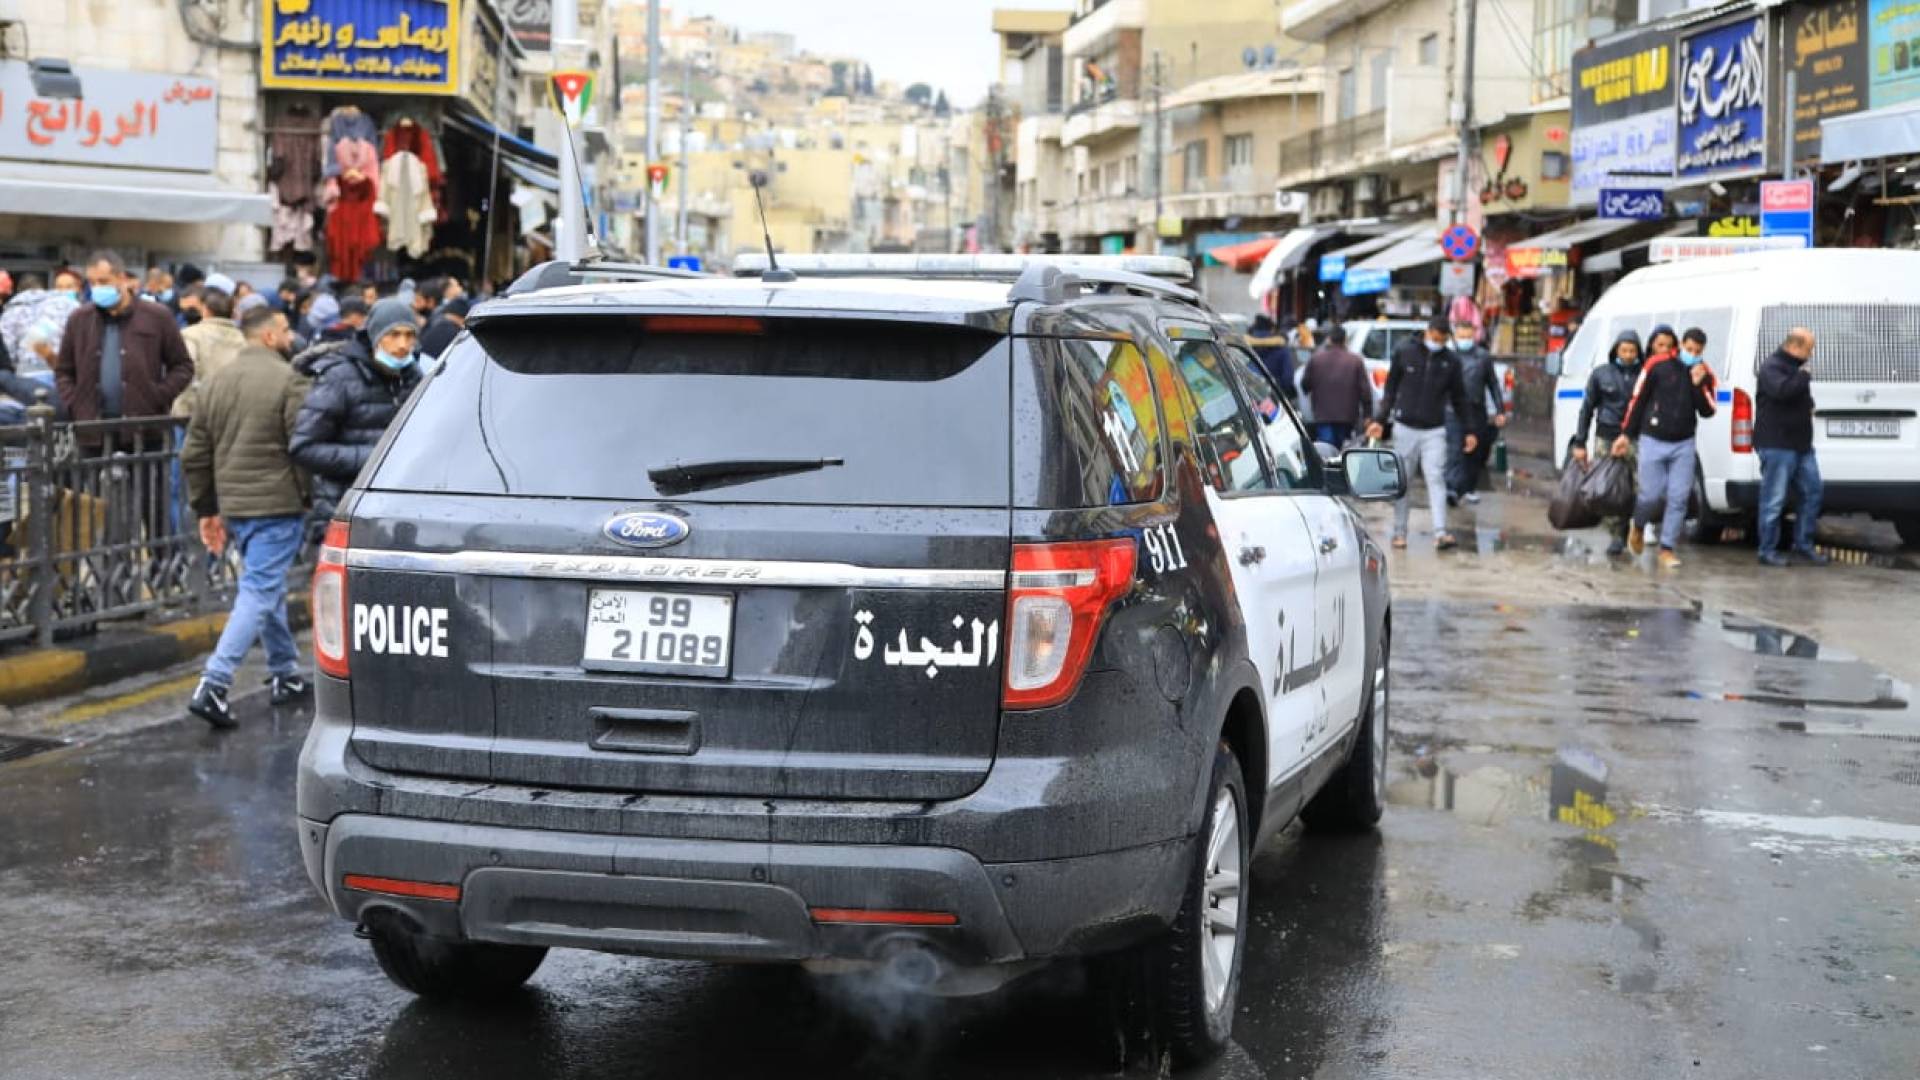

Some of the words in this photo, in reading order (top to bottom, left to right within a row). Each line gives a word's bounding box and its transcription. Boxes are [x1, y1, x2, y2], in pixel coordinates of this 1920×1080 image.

[620, 518, 669, 538] Ford
[1143, 521, 1188, 574] 911
[529, 560, 763, 580] EXPLORER
[353, 603, 449, 658] POLICE
[648, 596, 692, 628] 99
[611, 628, 722, 666] 21089
[853, 609, 999, 679] النجدة
